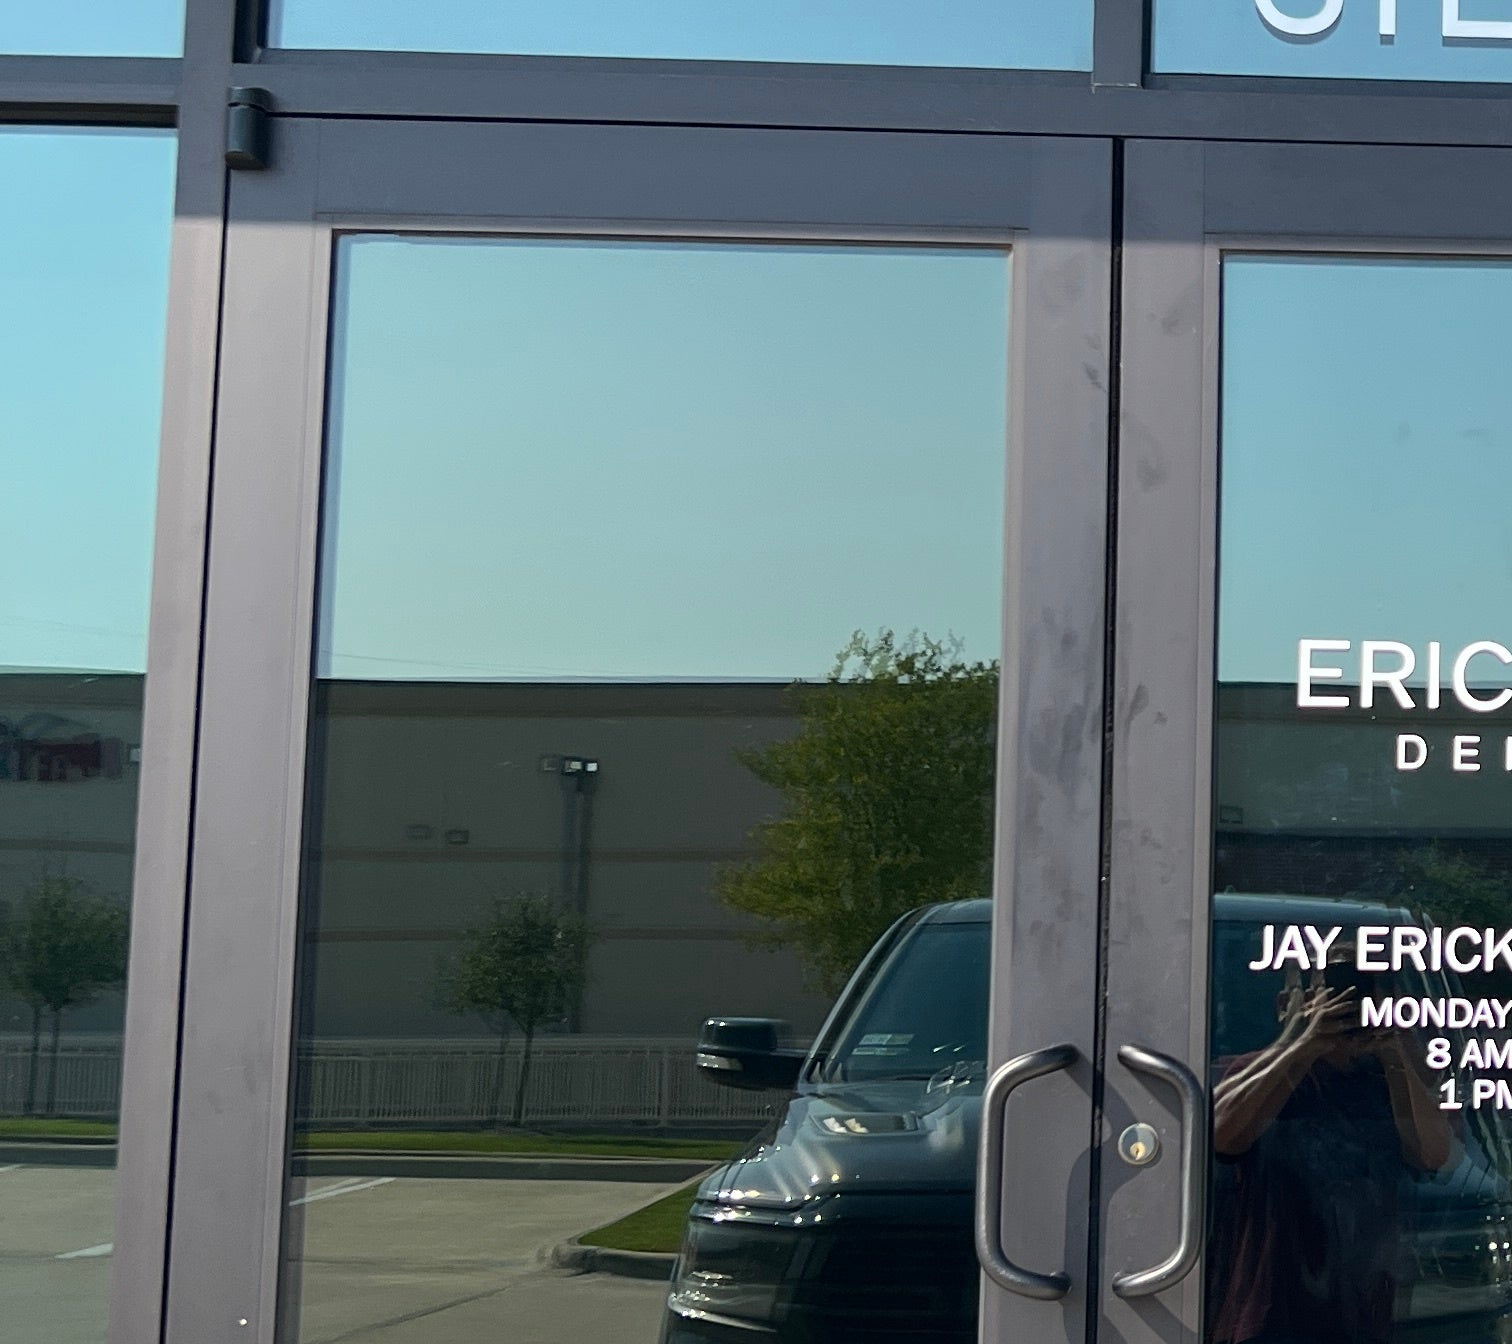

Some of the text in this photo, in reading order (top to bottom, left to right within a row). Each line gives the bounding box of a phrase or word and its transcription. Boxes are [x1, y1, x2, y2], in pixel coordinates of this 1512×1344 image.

[1249, 924, 1343, 971] JAY
[1425, 1037, 1452, 1070] 8
[1438, 1077, 1464, 1110] 1
